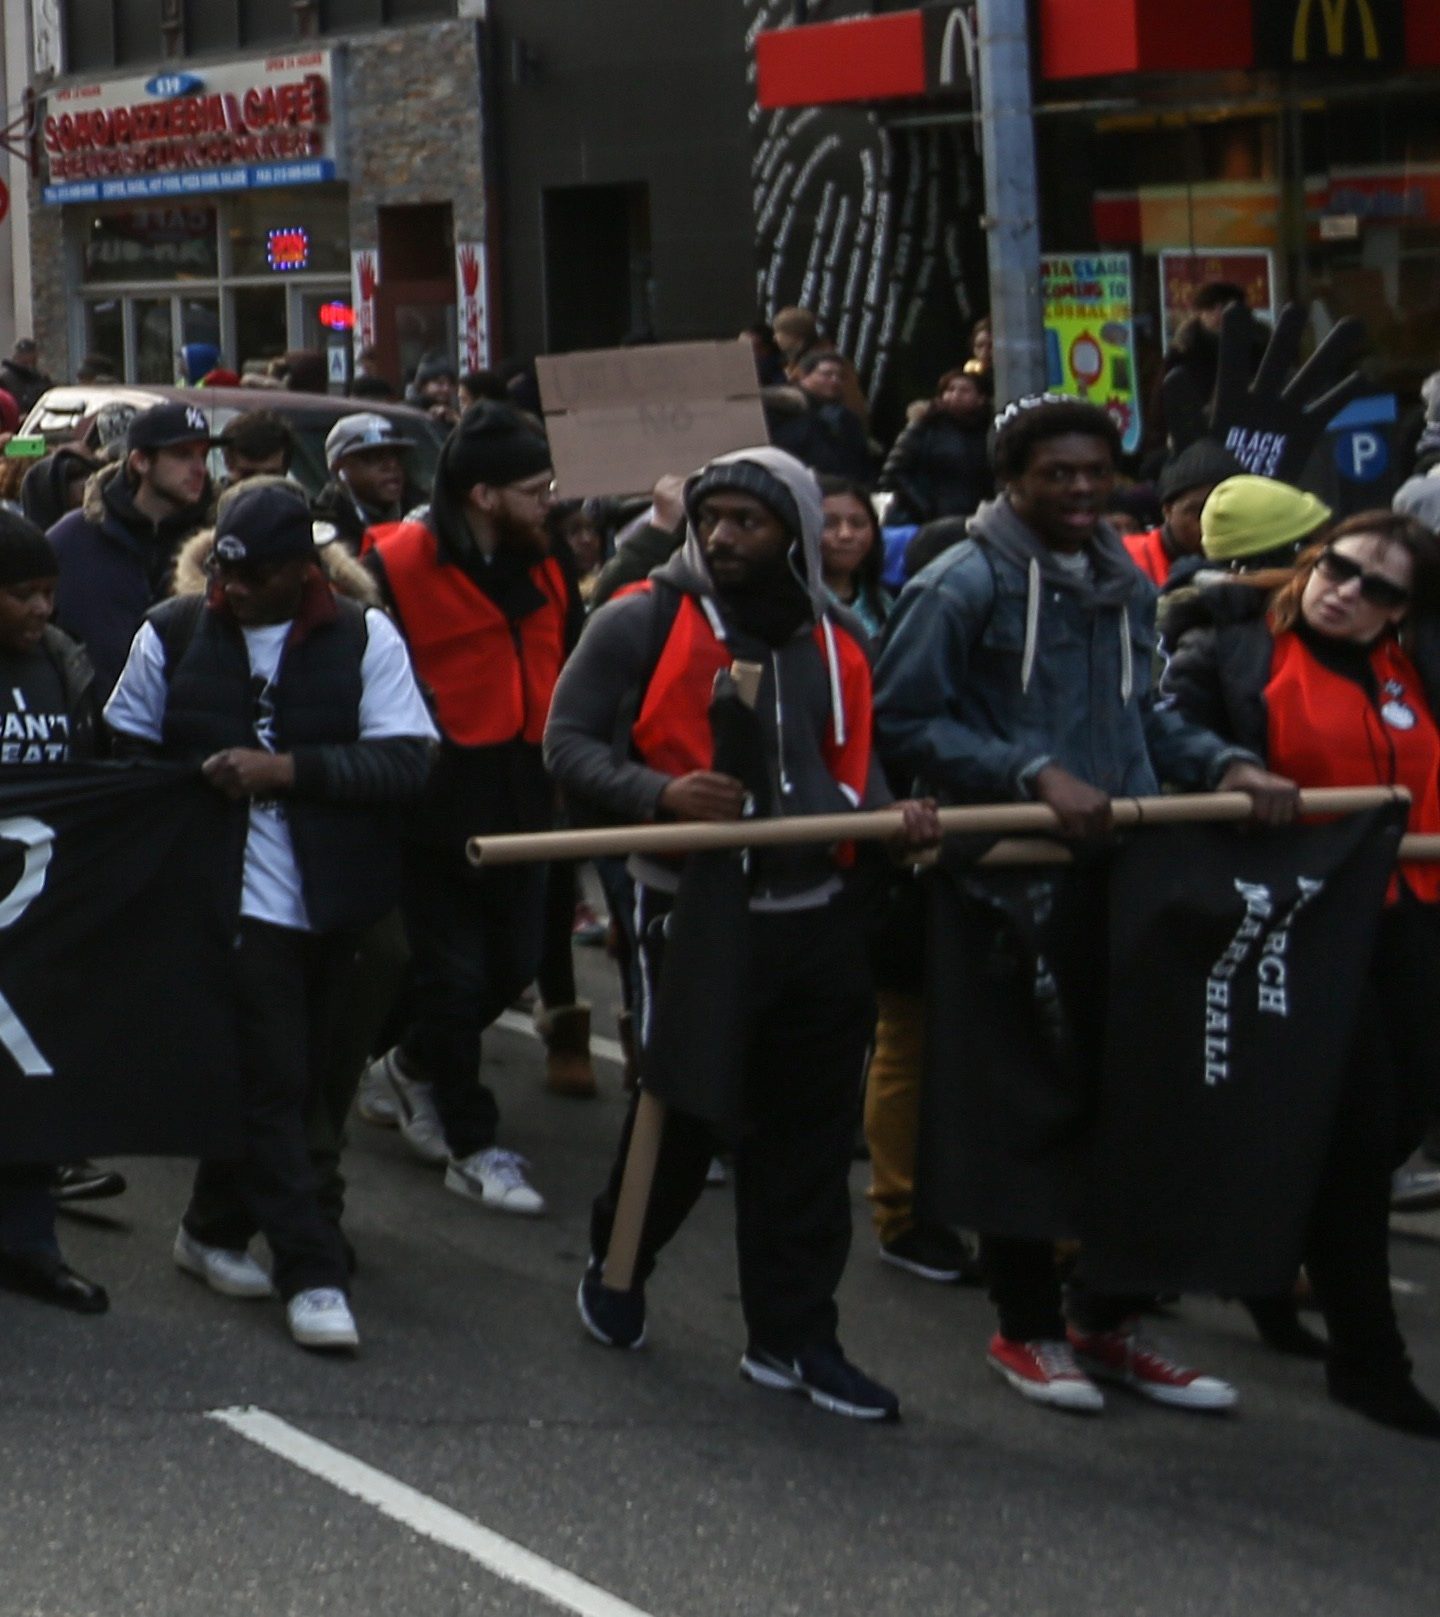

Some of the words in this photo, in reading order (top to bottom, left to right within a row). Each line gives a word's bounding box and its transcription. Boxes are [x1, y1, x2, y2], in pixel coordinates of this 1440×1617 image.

[1224, 425, 1287, 456] BLACK
[1352, 432, 1378, 477] P
[12, 687, 28, 712] I
